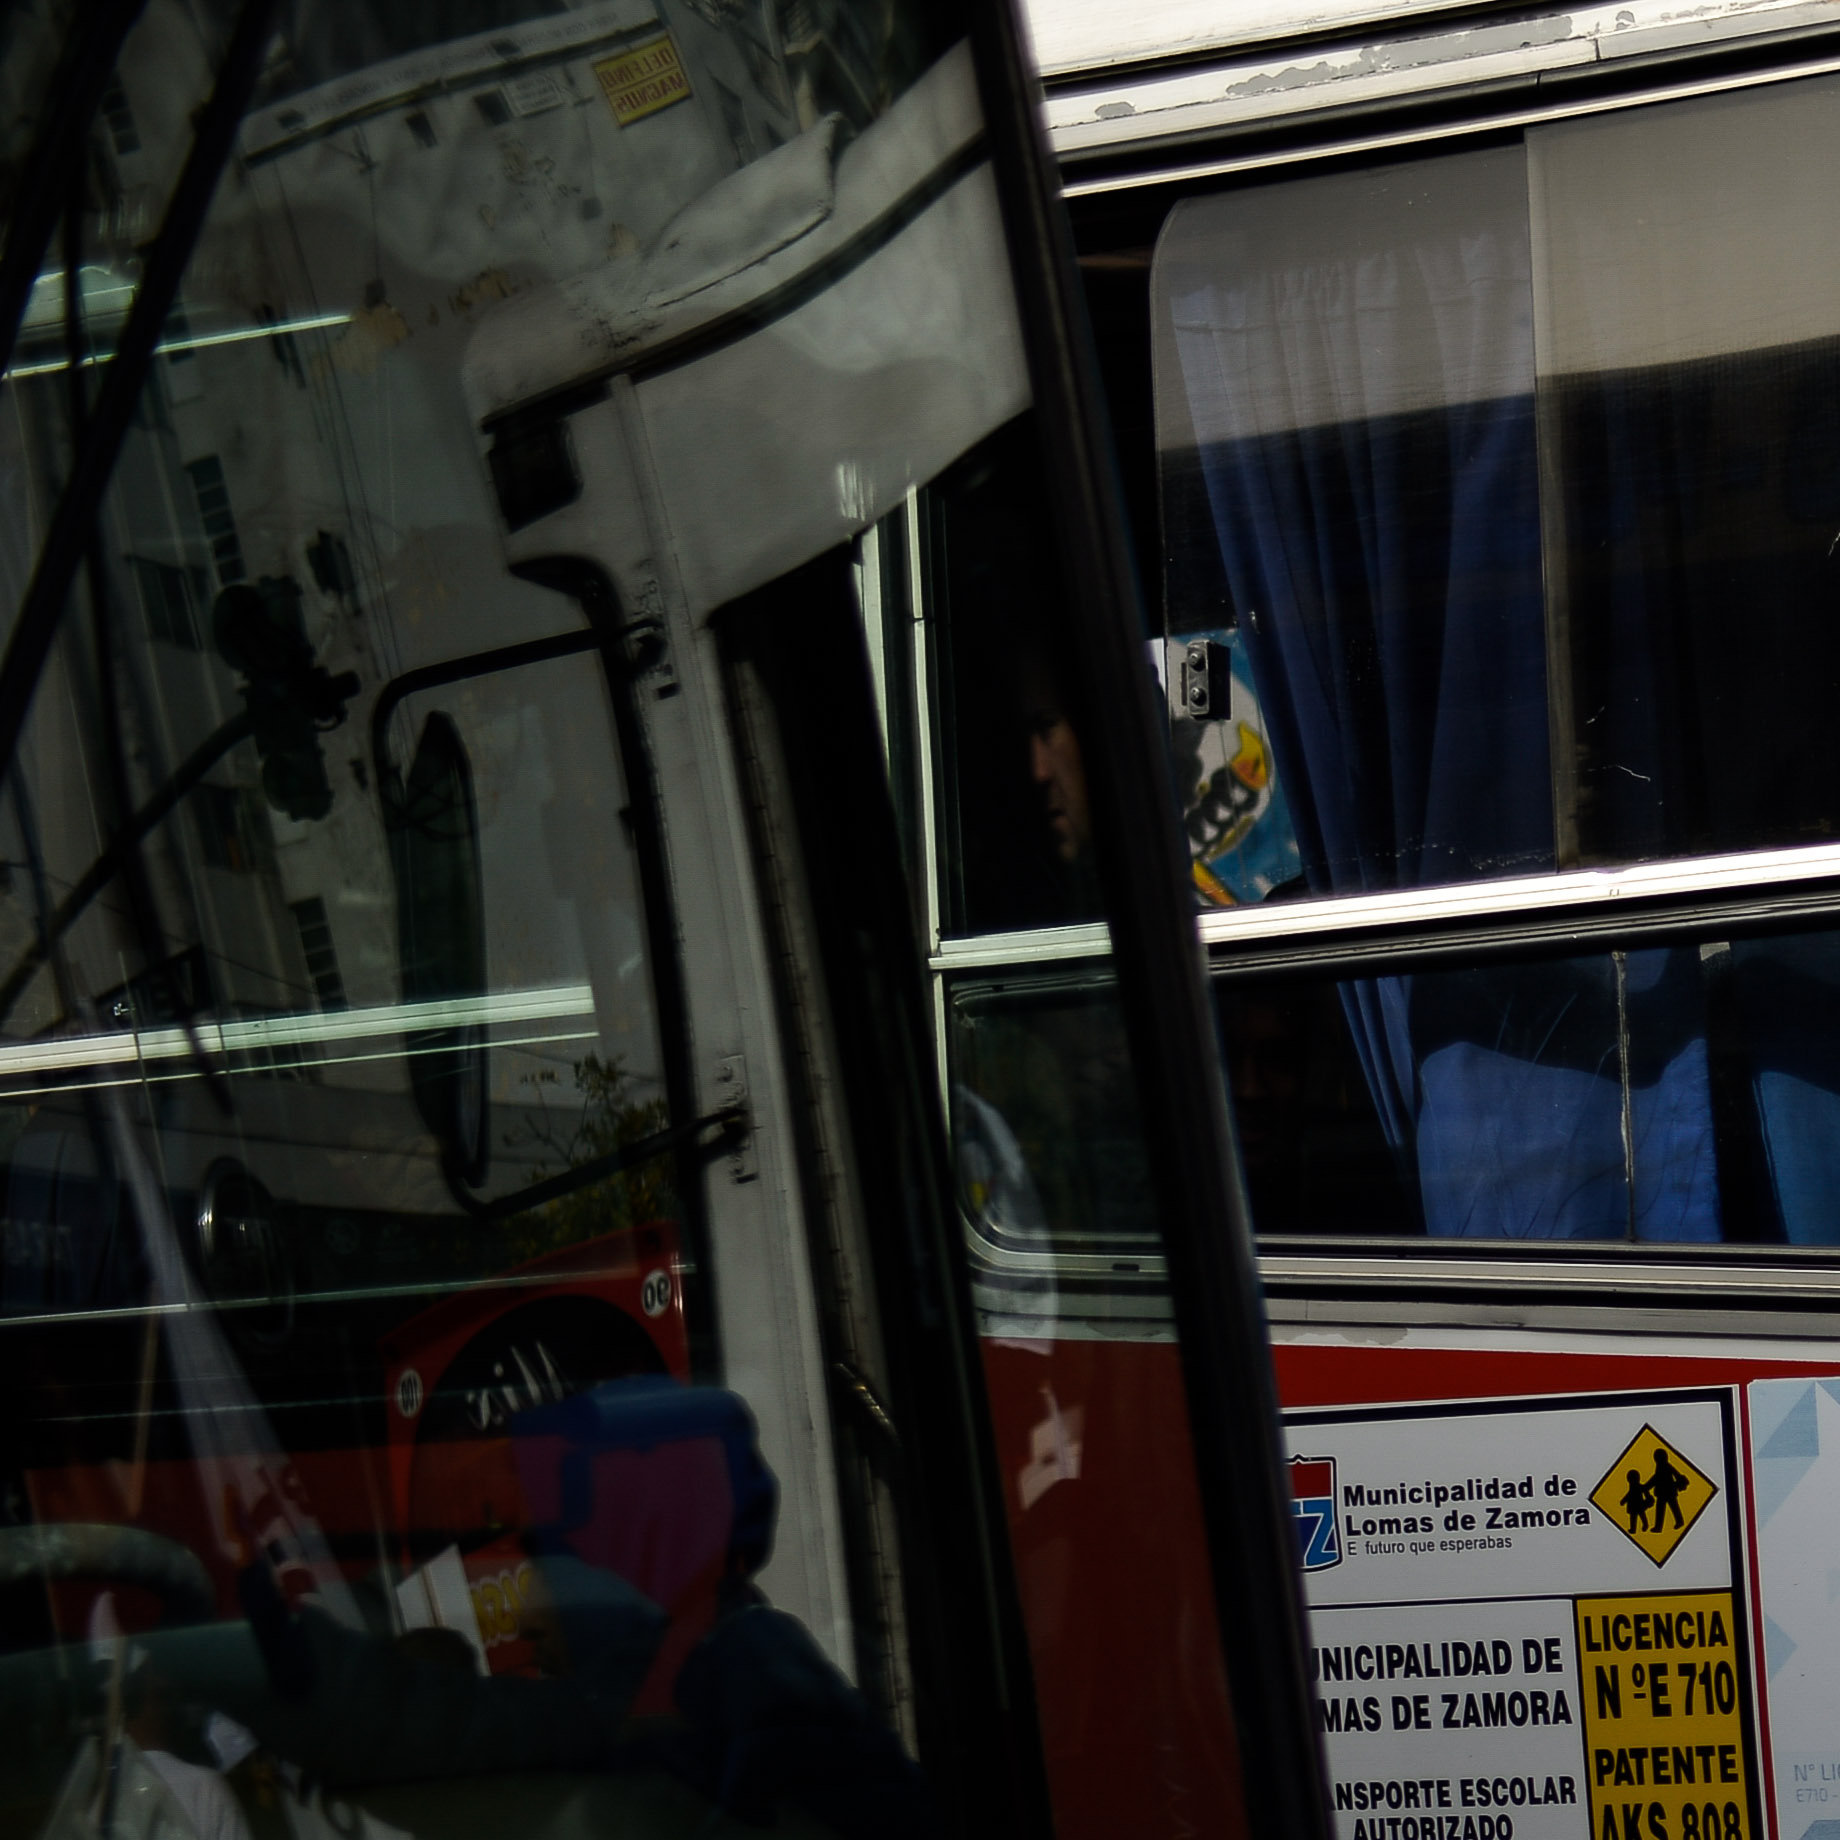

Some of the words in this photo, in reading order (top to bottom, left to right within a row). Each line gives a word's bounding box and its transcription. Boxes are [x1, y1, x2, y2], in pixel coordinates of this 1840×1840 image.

[1343, 1477, 1537, 1509] Municipalidad
[1543, 1475, 1577, 1498] de
[1345, 1512, 1434, 1536] Lomas
[1444, 1508, 1476, 1531] de
[1485, 1504, 1591, 1528] Zamora
[1365, 1540, 1405, 1555] futuro
[1409, 1541, 1435, 1556] que
[1439, 1535, 1513, 1555] esperabas
[1583, 1611, 1728, 1652] LICENCIA
[1523, 1638, 1563, 1673] DE
[1677, 1660, 1736, 1716] 710
[1392, 1695, 1432, 1730] DE
[1443, 1690, 1573, 1728] ZAMORA
[1595, 1745, 1739, 1787] PATENTE
[1460, 1776, 1577, 1807] ESCOLAR
